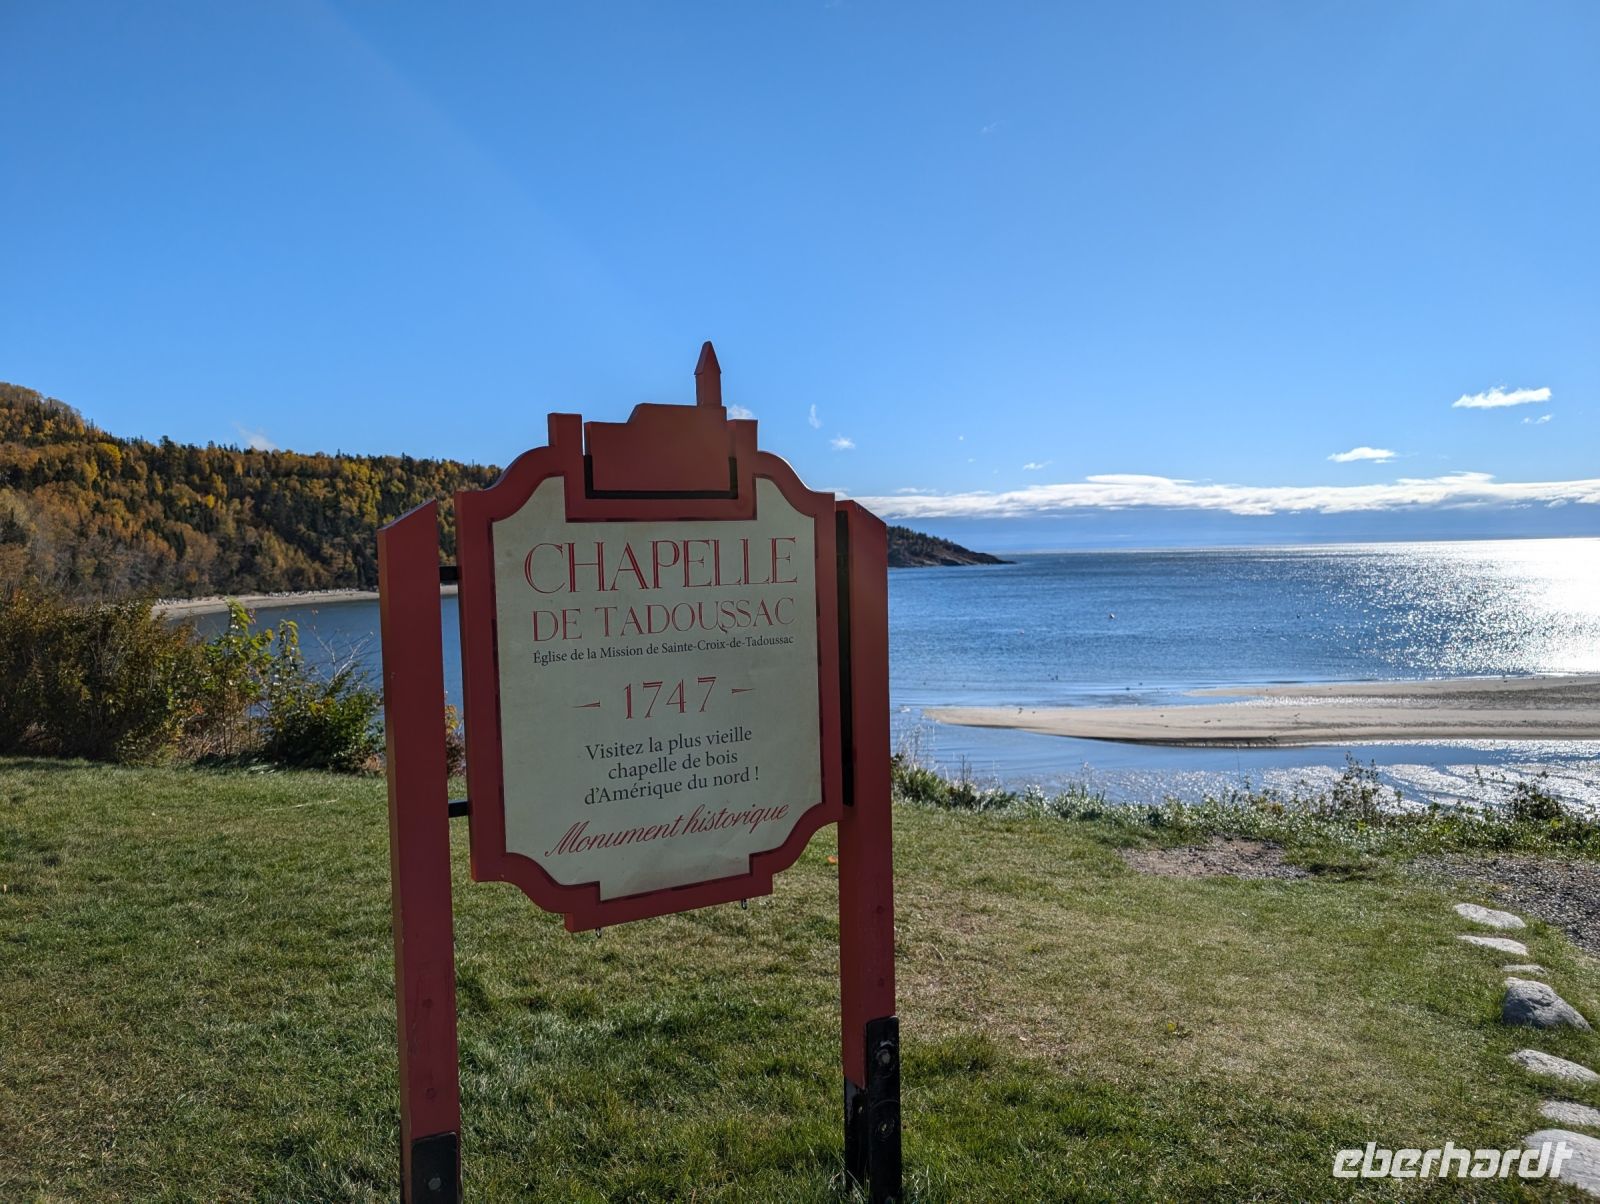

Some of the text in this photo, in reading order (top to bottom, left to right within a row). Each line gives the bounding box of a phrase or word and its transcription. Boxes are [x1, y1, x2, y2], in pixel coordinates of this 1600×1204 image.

[524, 537, 798, 594] CHAPELLE
[532, 598, 794, 642] DE TADOUSSAC
[533, 635, 795, 666] Église de la Mission de Sainte-Croix-de-Tadoussac
[624, 676, 717, 719] 1747
[585, 726, 753, 760] Visitez la plus vieille
[608, 750, 738, 781] chapelle de bois
[687, 773, 708, 790] du
[544, 803, 790, 857] Monument historique
